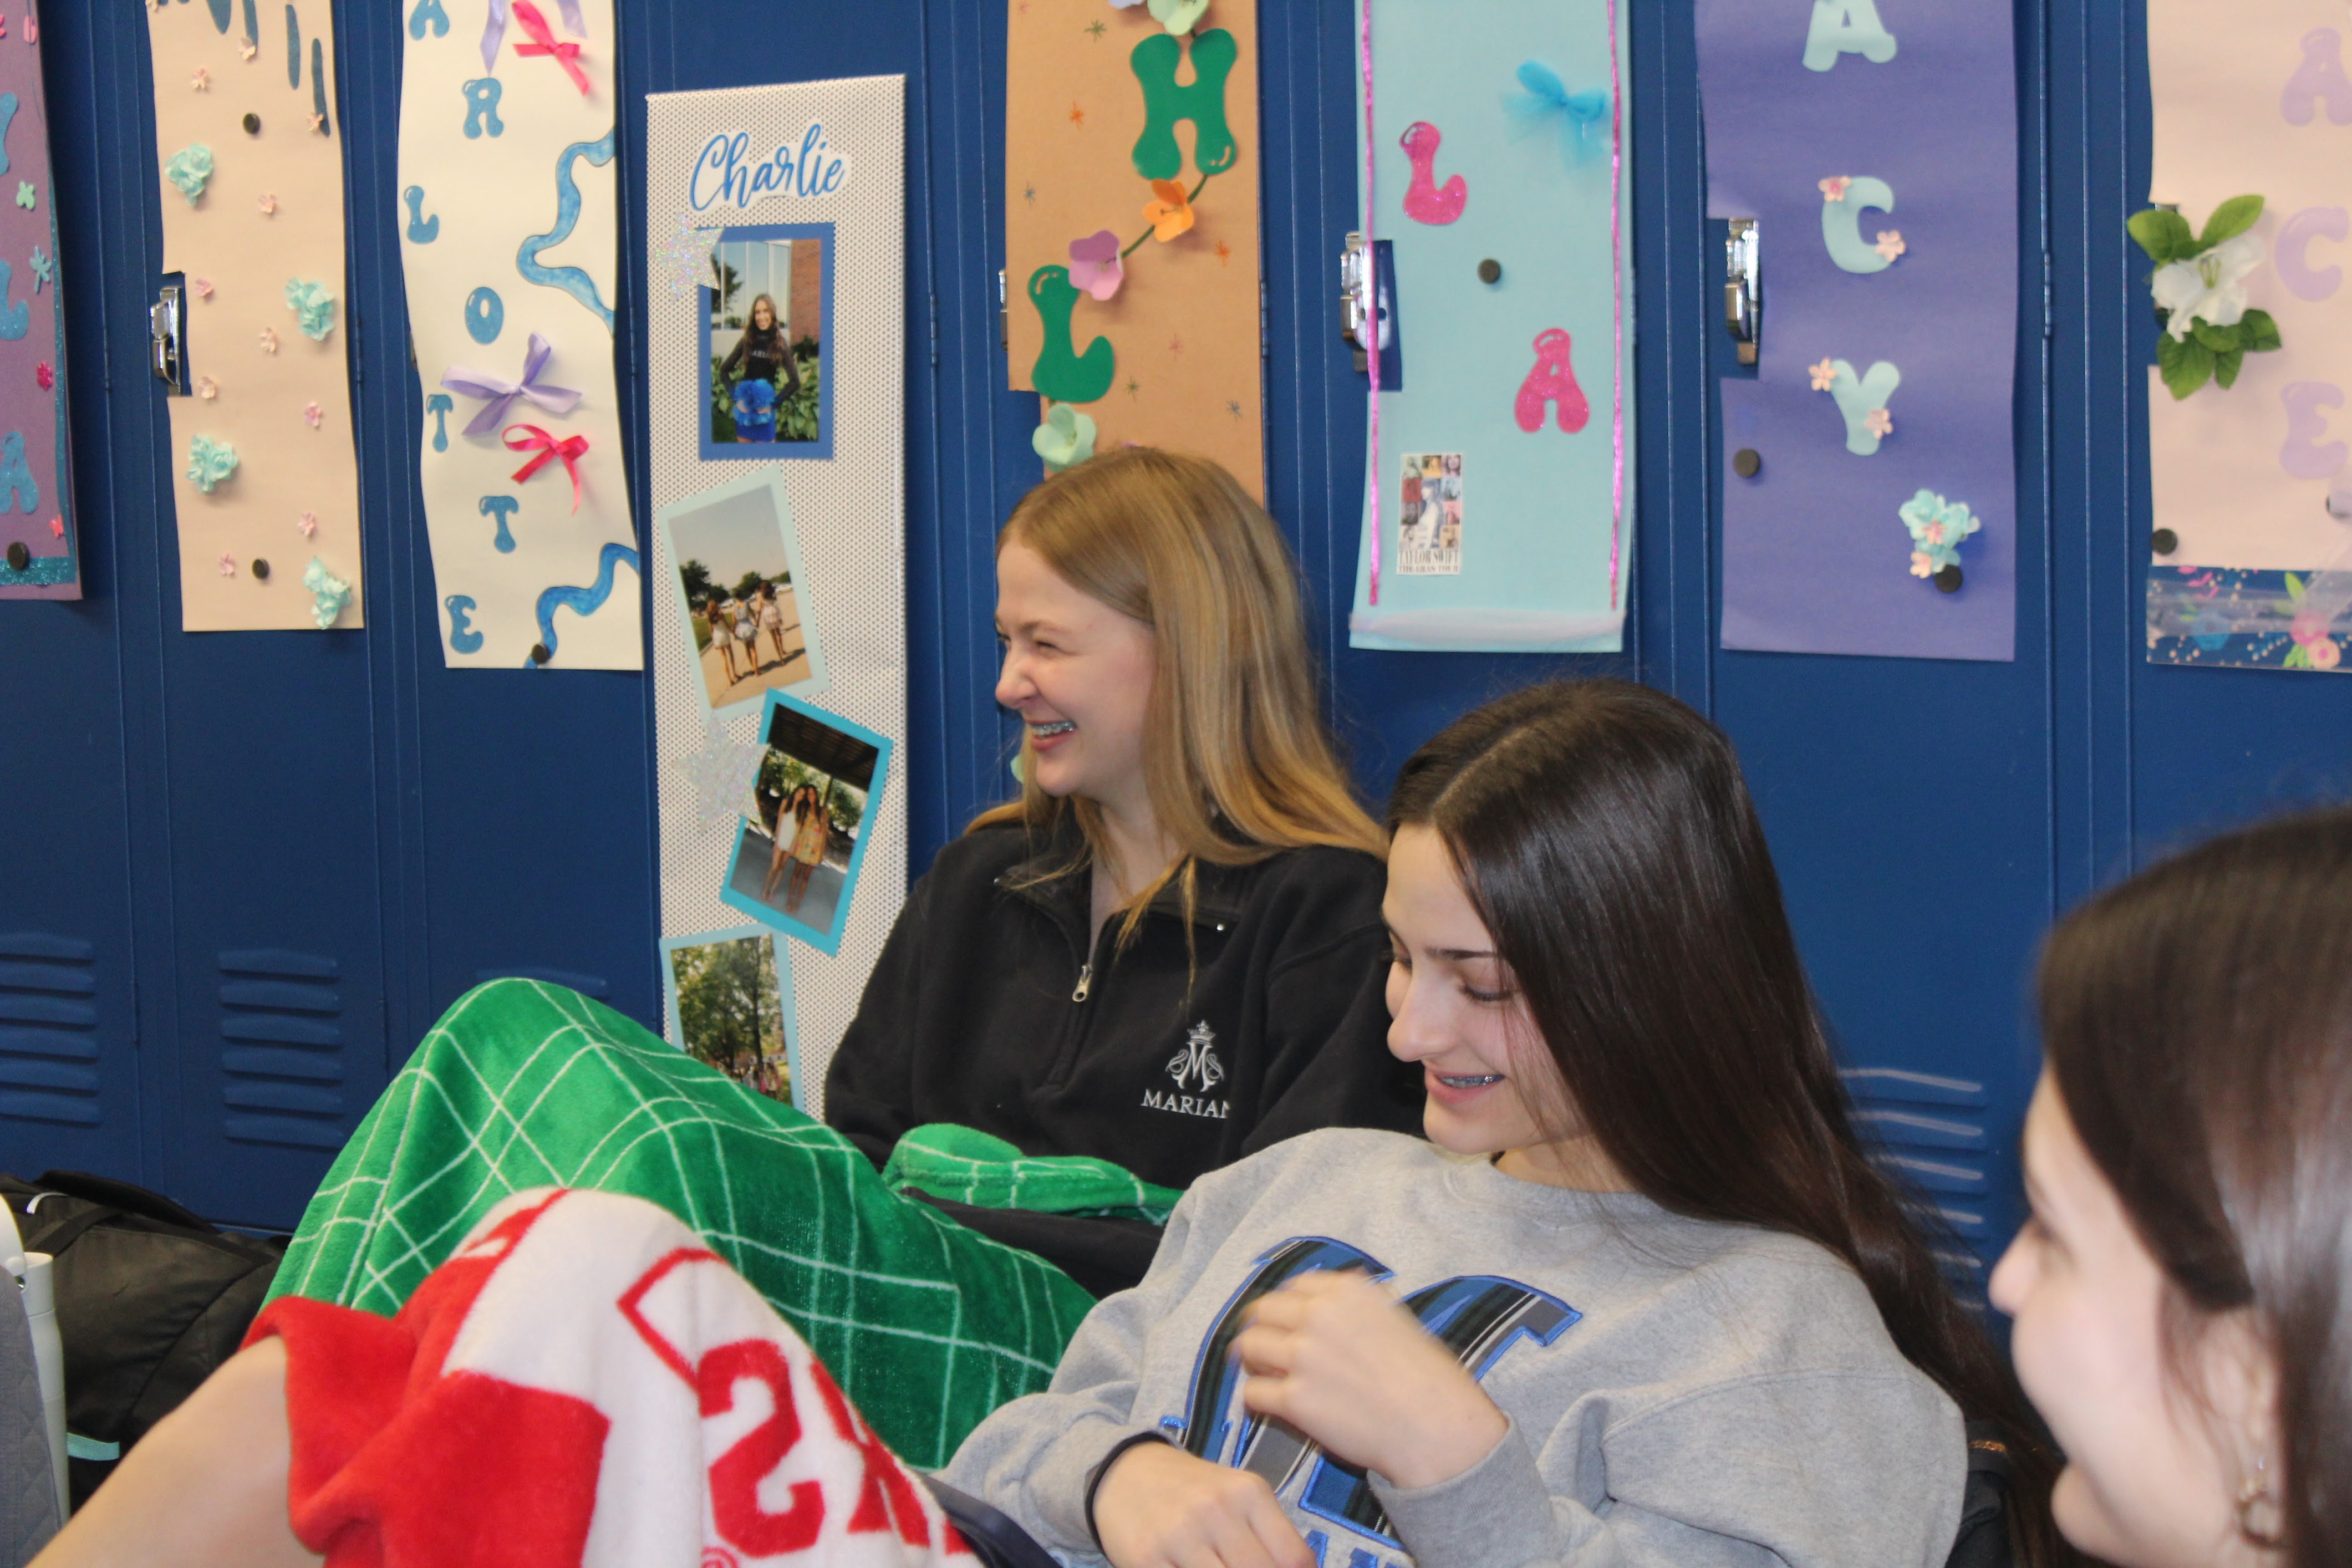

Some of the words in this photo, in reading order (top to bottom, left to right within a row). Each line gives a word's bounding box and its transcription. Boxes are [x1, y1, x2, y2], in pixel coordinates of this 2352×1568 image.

[689, 124, 845, 211] Charlie
[1399, 549, 1430, 564] TAYLOR
[1433, 549, 1459, 564] SWIFT
